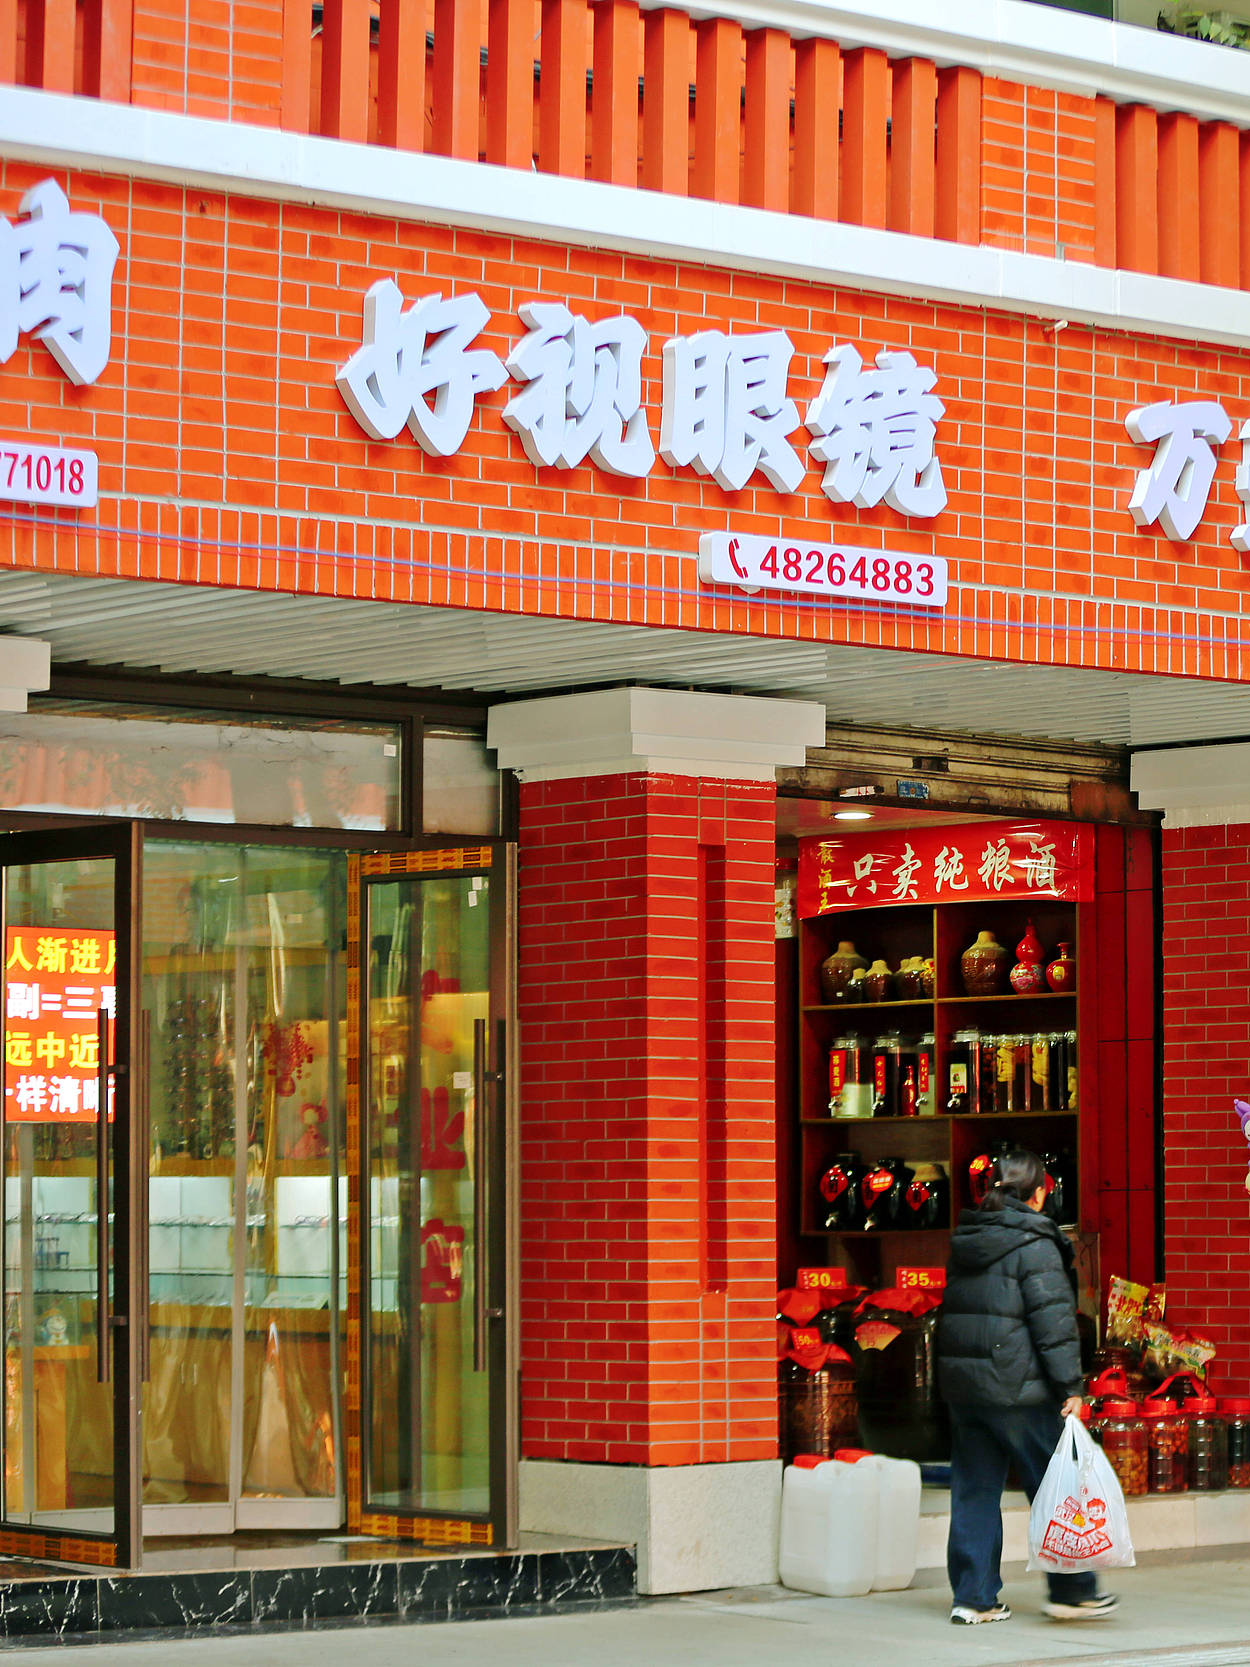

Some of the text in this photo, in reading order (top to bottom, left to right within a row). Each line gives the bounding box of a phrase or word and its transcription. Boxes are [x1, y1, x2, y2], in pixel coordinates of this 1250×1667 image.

[0, 177, 121, 386] 肉
[335, 278, 947, 518] 好视眼镜
[0, 451, 84, 495] 71018
[759, 544, 935, 597] 48264883
[847, 838, 1061, 900] 只卖纯粮酒
[5, 1075, 116, 1114] 样清晰
[808, 1272, 831, 1287] 30
[907, 1272, 930, 1287] 35
